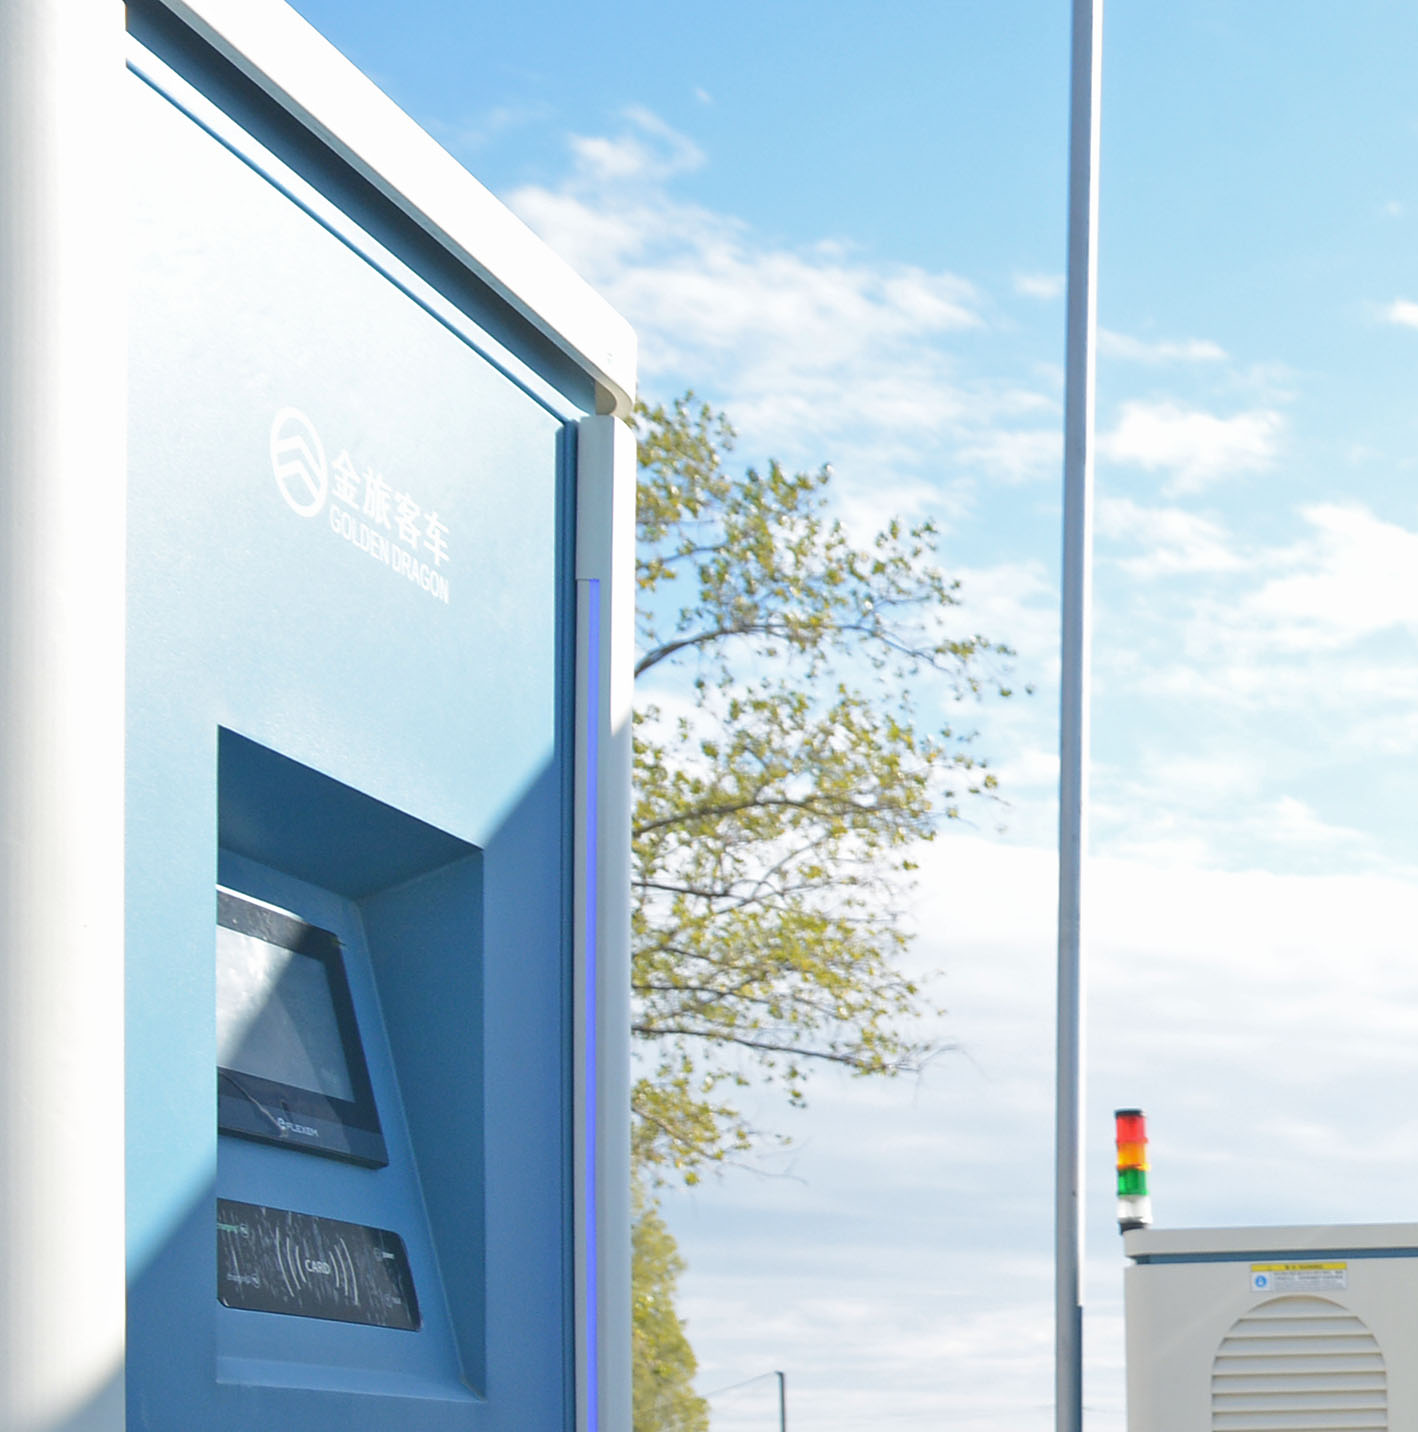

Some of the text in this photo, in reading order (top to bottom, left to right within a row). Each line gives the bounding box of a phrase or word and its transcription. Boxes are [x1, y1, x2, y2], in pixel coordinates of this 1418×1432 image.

[329, 504, 450, 605] GOLDEN DRAGON
[304, 1258, 332, 1276] CARD
